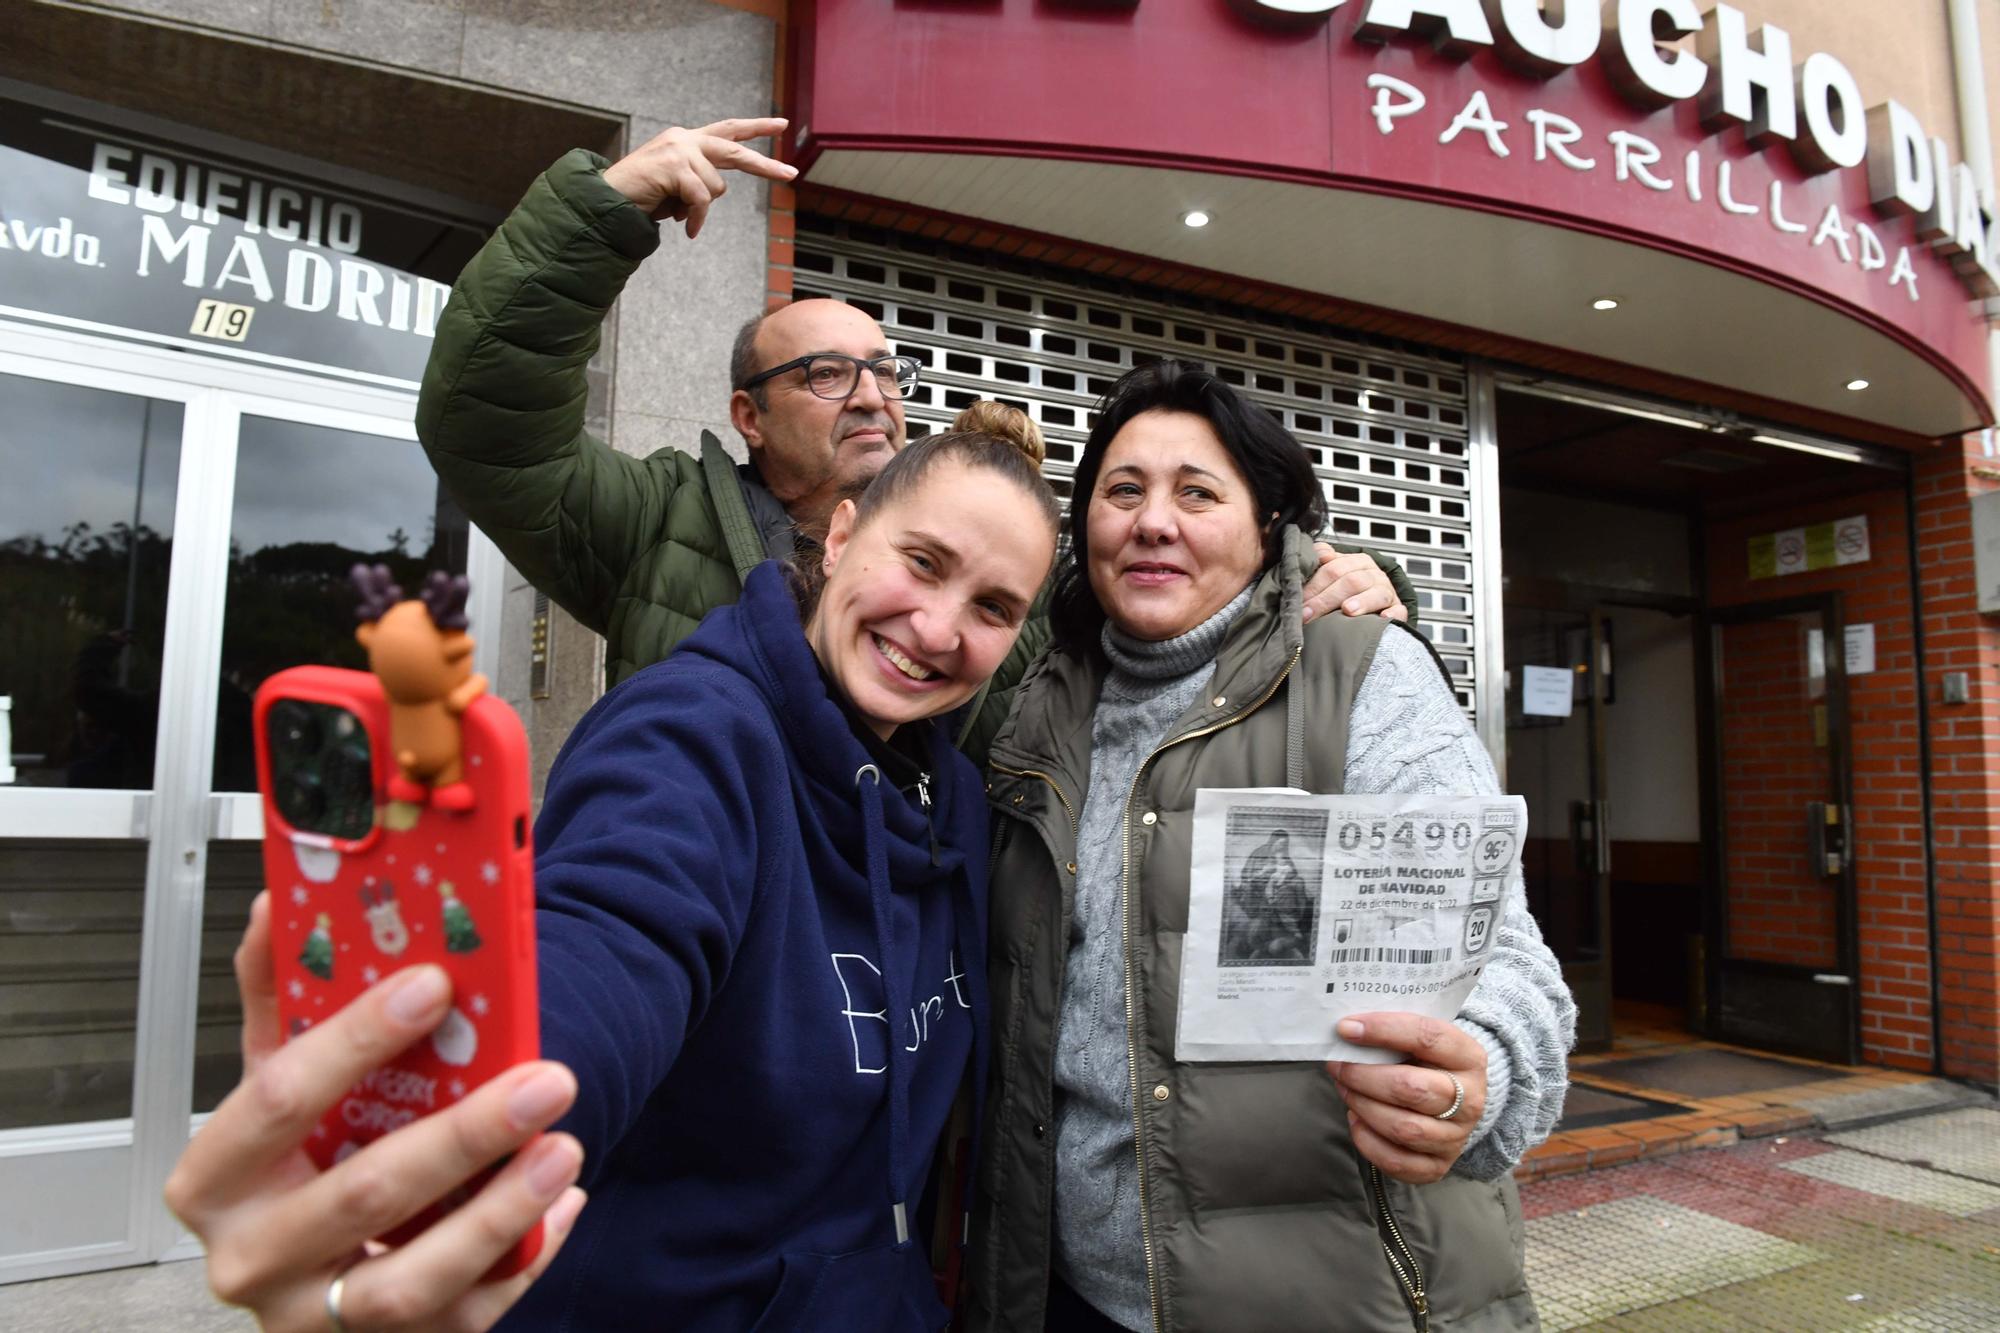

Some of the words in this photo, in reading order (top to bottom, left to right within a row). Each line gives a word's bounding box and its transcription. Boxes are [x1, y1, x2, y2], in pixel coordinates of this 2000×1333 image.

[1256, 0, 1867, 168] UCHO
[88, 142, 364, 255] EDIFICIO
[1367, 74, 1919, 301] PARRILLADA
[197, 304, 248, 338] 19
[1338, 821, 1472, 851] 05490
[1396, 866, 1466, 879] NACIONAL
[1358, 884, 1376, 895] DE
[1379, 882, 1446, 895] NAVIDAD
[1340, 900, 1353, 910] 22
[1355, 899, 1368, 910] de
[1369, 898, 1419, 910] diciembre
[1422, 899, 1436, 910] de
[1470, 920, 1485, 938] 20
